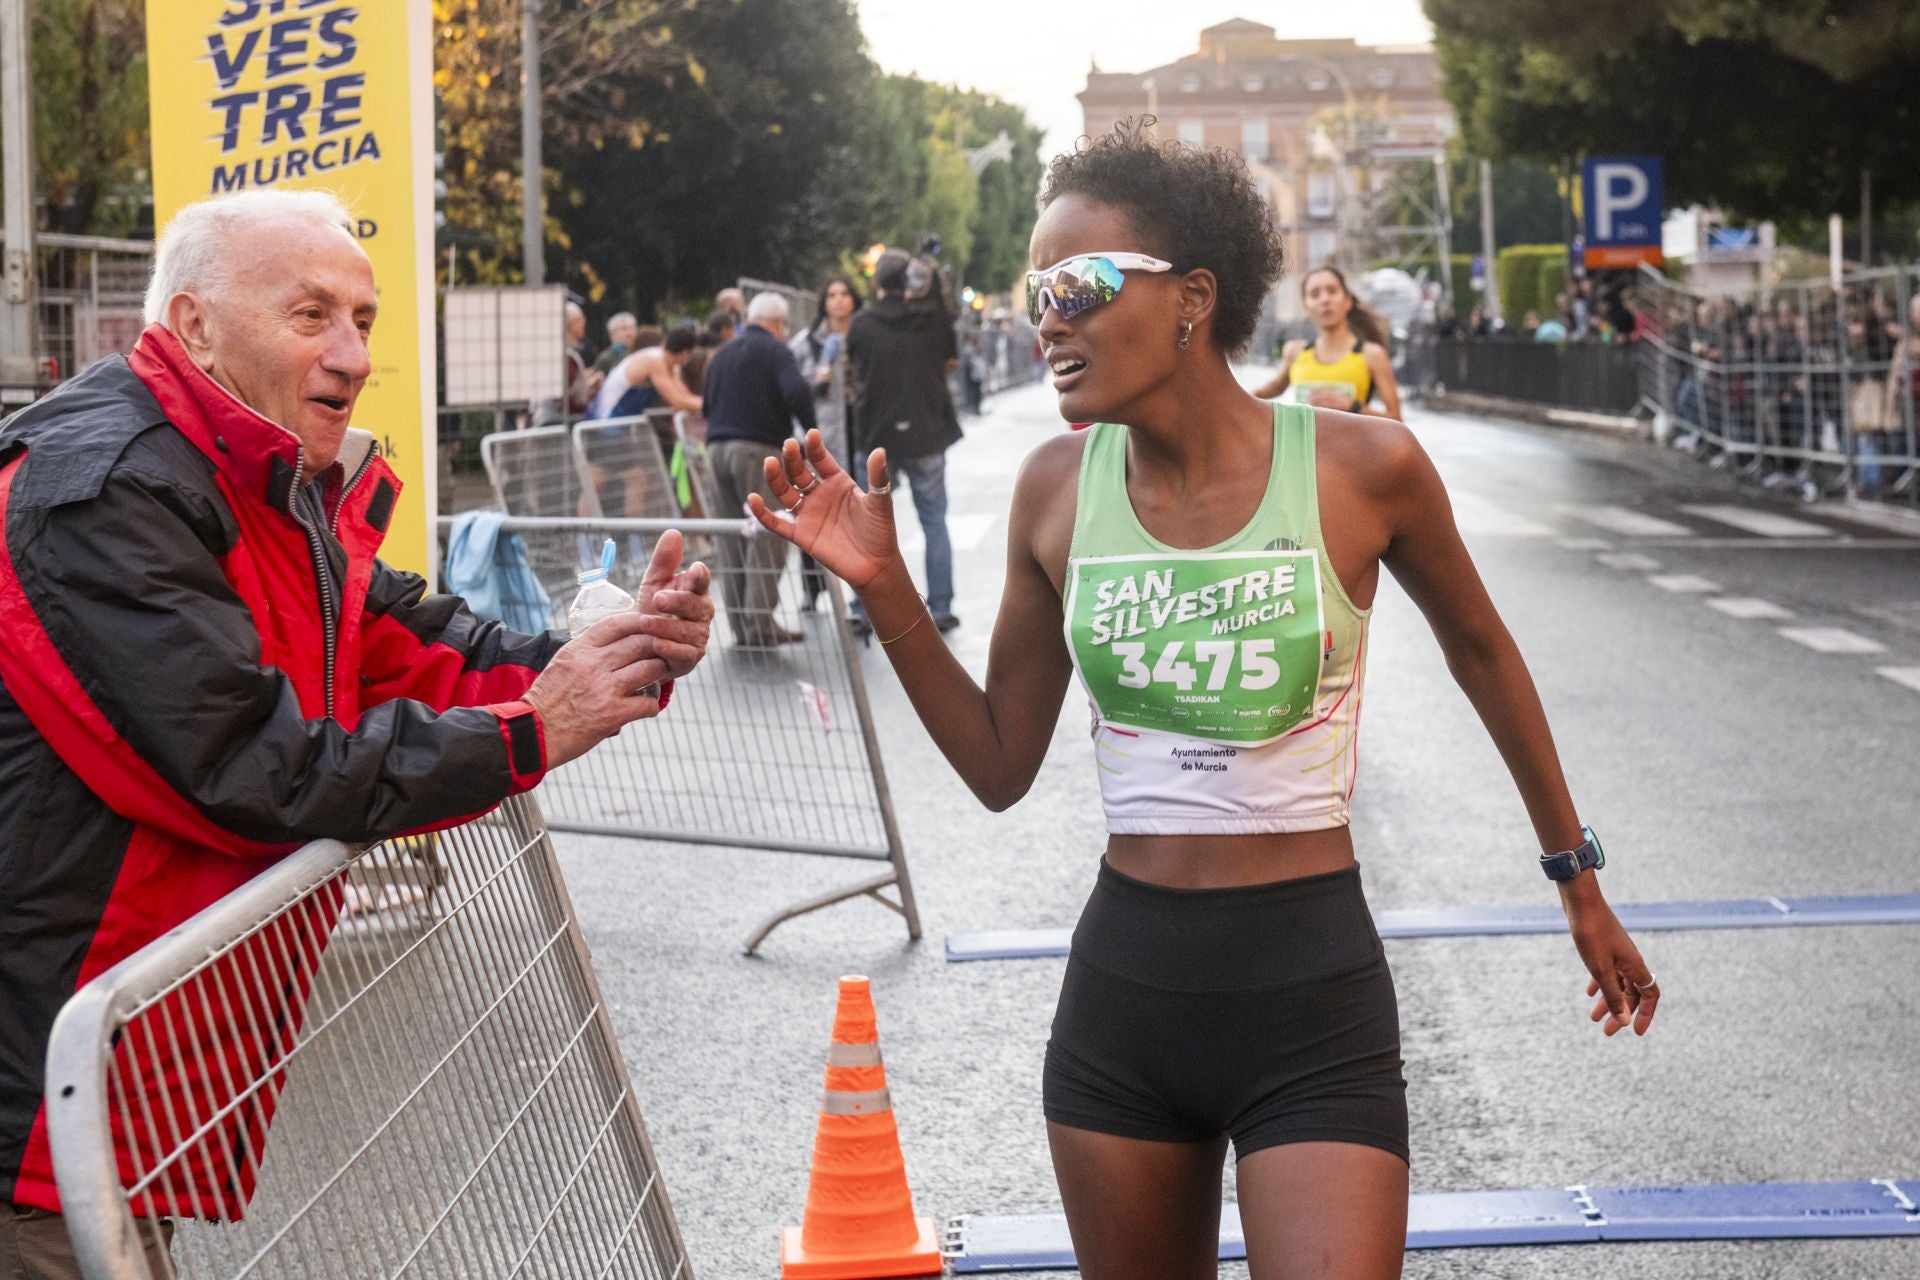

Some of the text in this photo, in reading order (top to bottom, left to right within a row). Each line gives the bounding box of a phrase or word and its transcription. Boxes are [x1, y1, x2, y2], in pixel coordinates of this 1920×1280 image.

[204, 7, 360, 88] VES
[208, 73, 366, 153] TRE
[211, 132, 381, 194] MURCIA
[1594, 164, 1648, 239] P
[1089, 565, 1296, 645] SILVESTRE
[1091, 568, 1174, 612] SAN
[1210, 599, 1296, 636] MURCIA
[1111, 638, 1281, 691] 3475
[1171, 747, 1237, 758] Ayuntamiento
[1181, 762, 1228, 771] de Murcia
